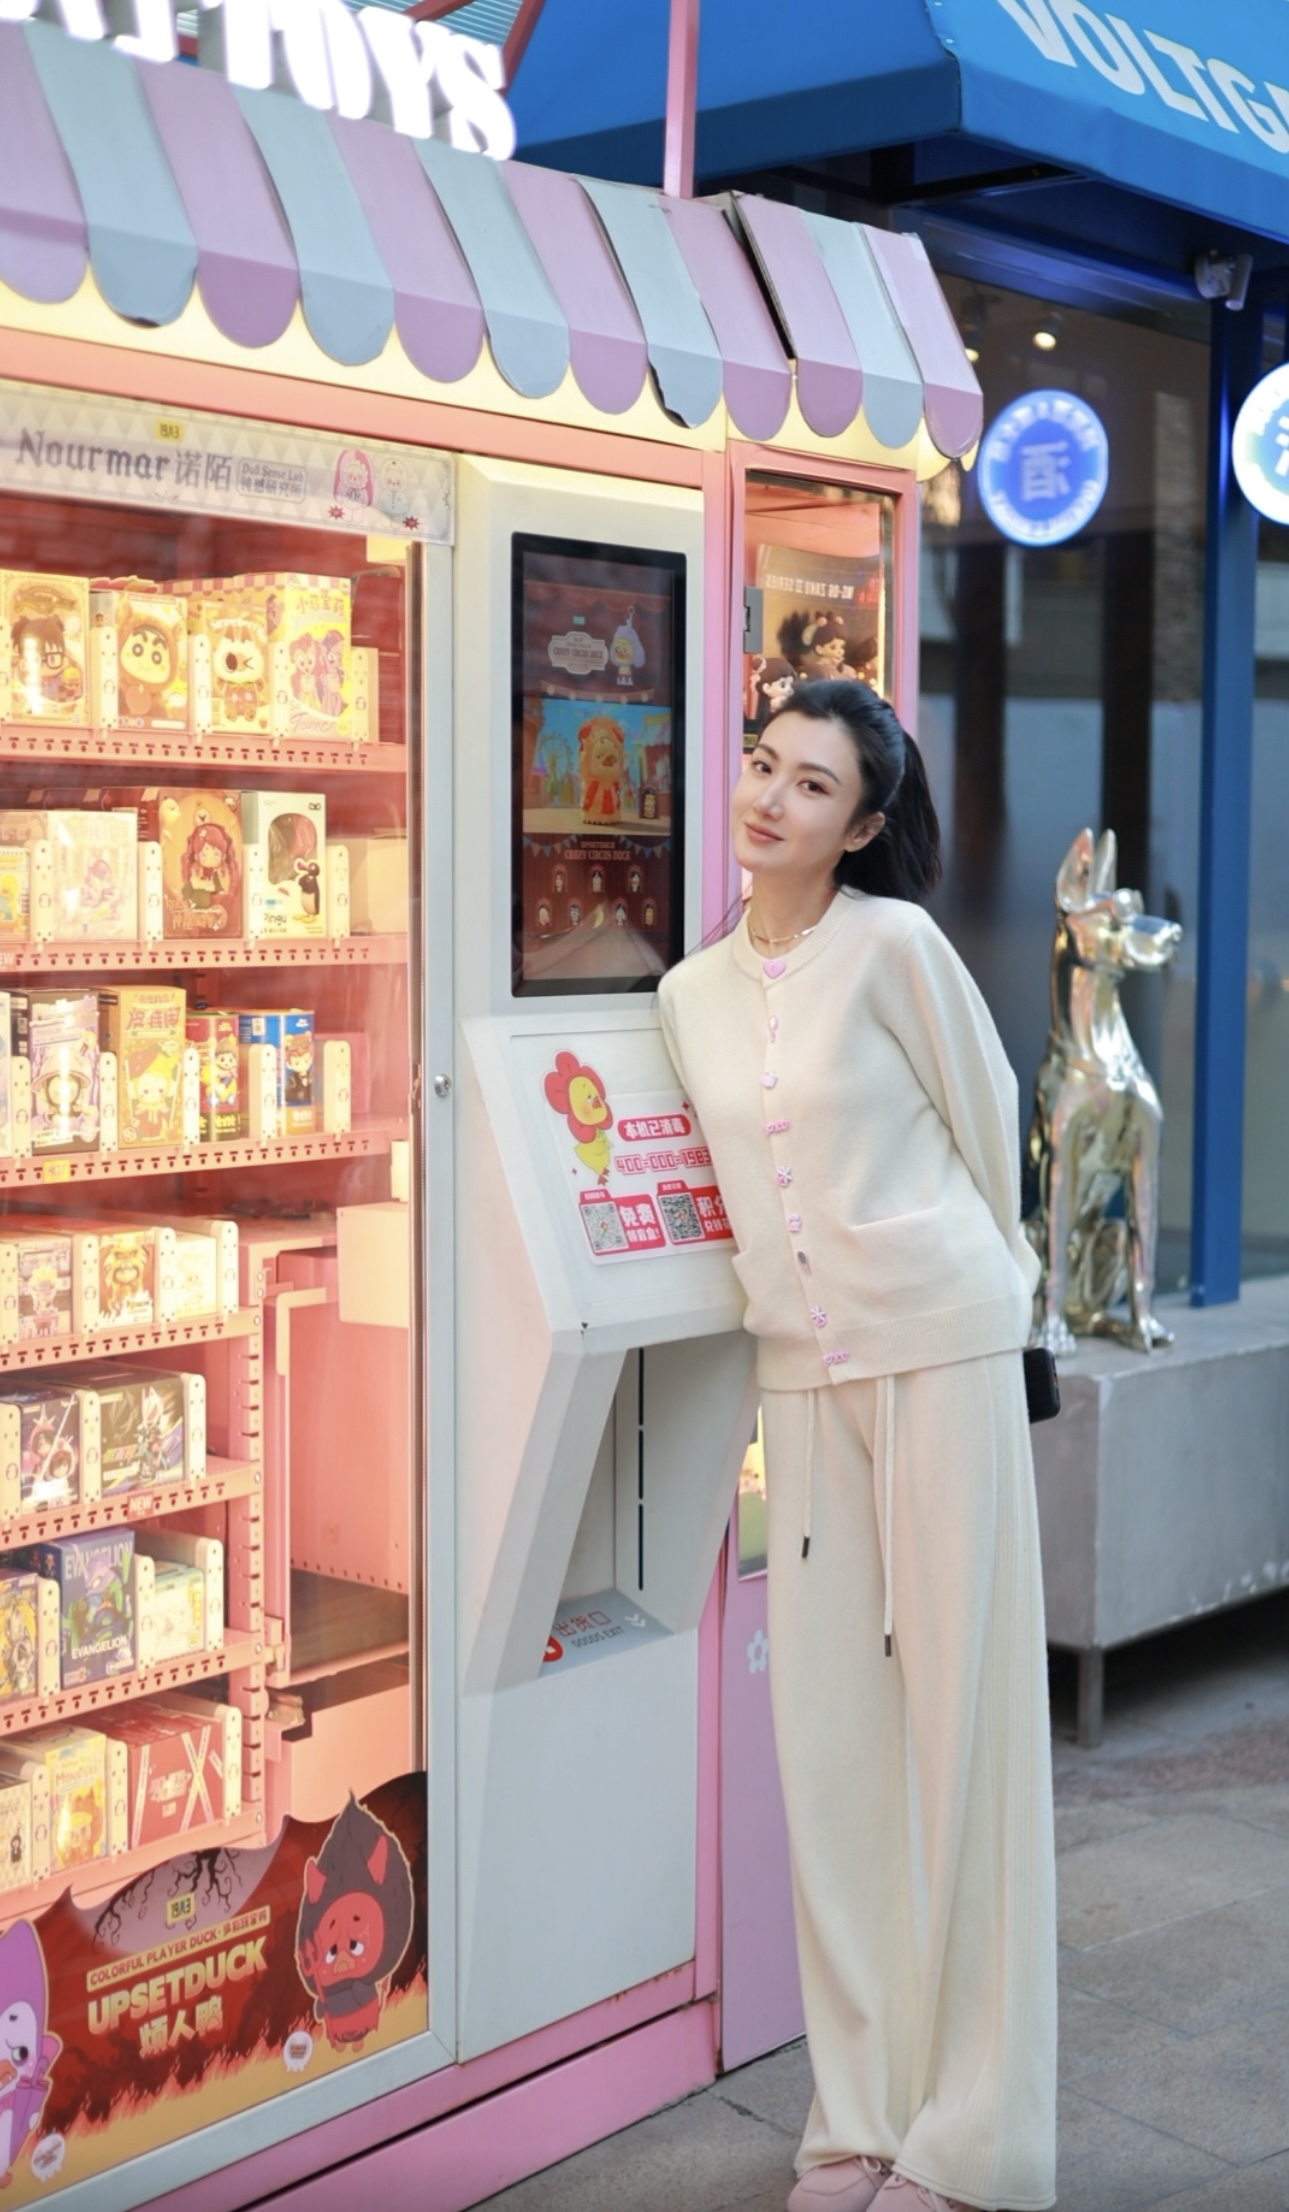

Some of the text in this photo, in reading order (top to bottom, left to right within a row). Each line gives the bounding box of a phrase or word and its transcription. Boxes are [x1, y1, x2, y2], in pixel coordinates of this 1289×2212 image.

[15, 427, 233, 492] Nourmar 诺陌
[71, 1634, 128, 1660] EVANGELION
[87, 1935, 268, 2035] UPSETDUCK
[90, 1954, 145, 1986] COLORFUL
[146, 1938, 187, 1966] PLAYER
[189, 1928, 218, 1948] DUCK
[138, 1994, 223, 2060] 烦人鸭
